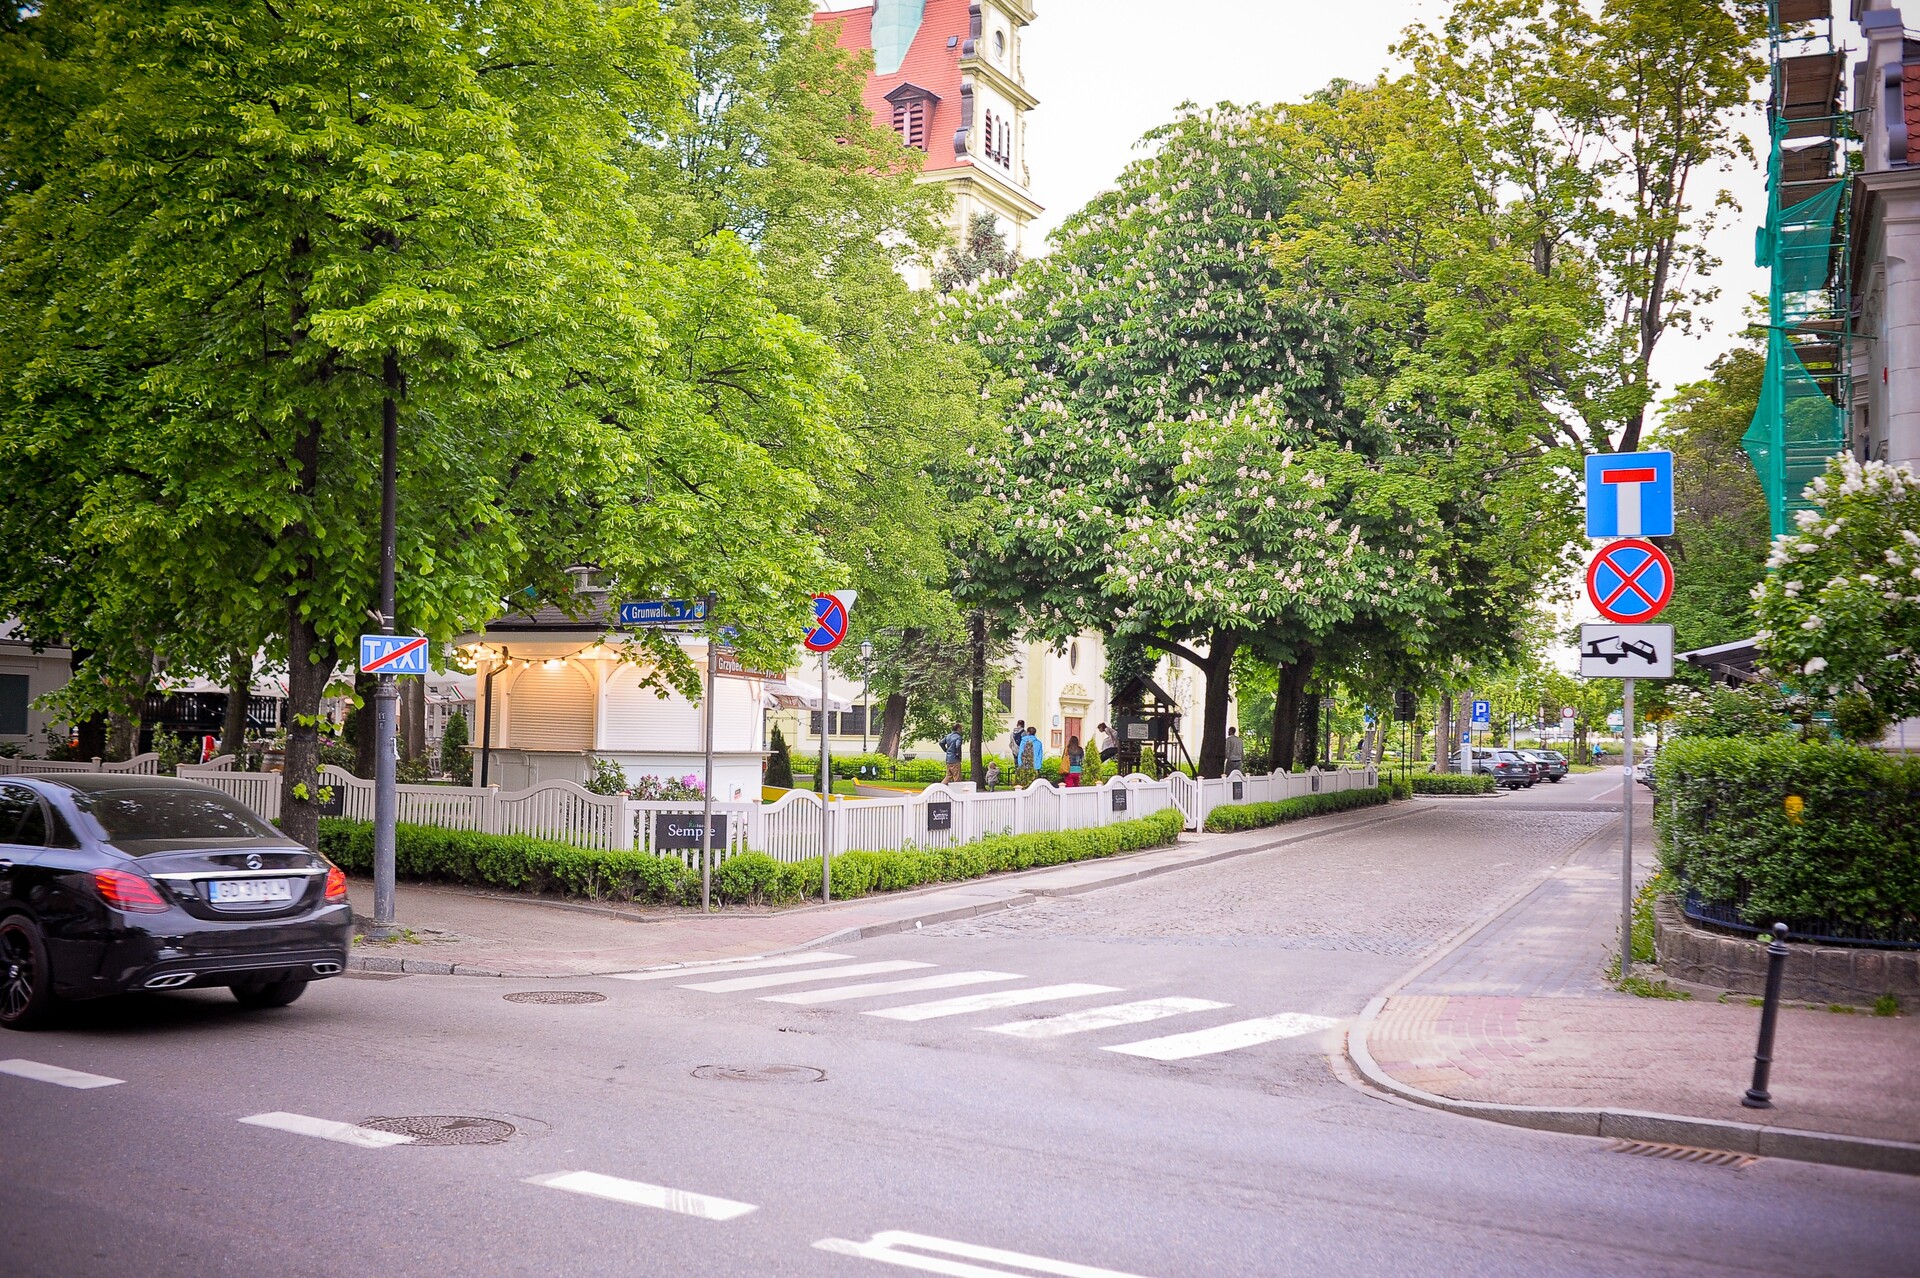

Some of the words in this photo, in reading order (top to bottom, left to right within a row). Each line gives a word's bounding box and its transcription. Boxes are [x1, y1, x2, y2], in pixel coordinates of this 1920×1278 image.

[363, 640, 424, 669] TAXI
[1475, 703, 1487, 716] P
[668, 824, 716, 841] Sempe
